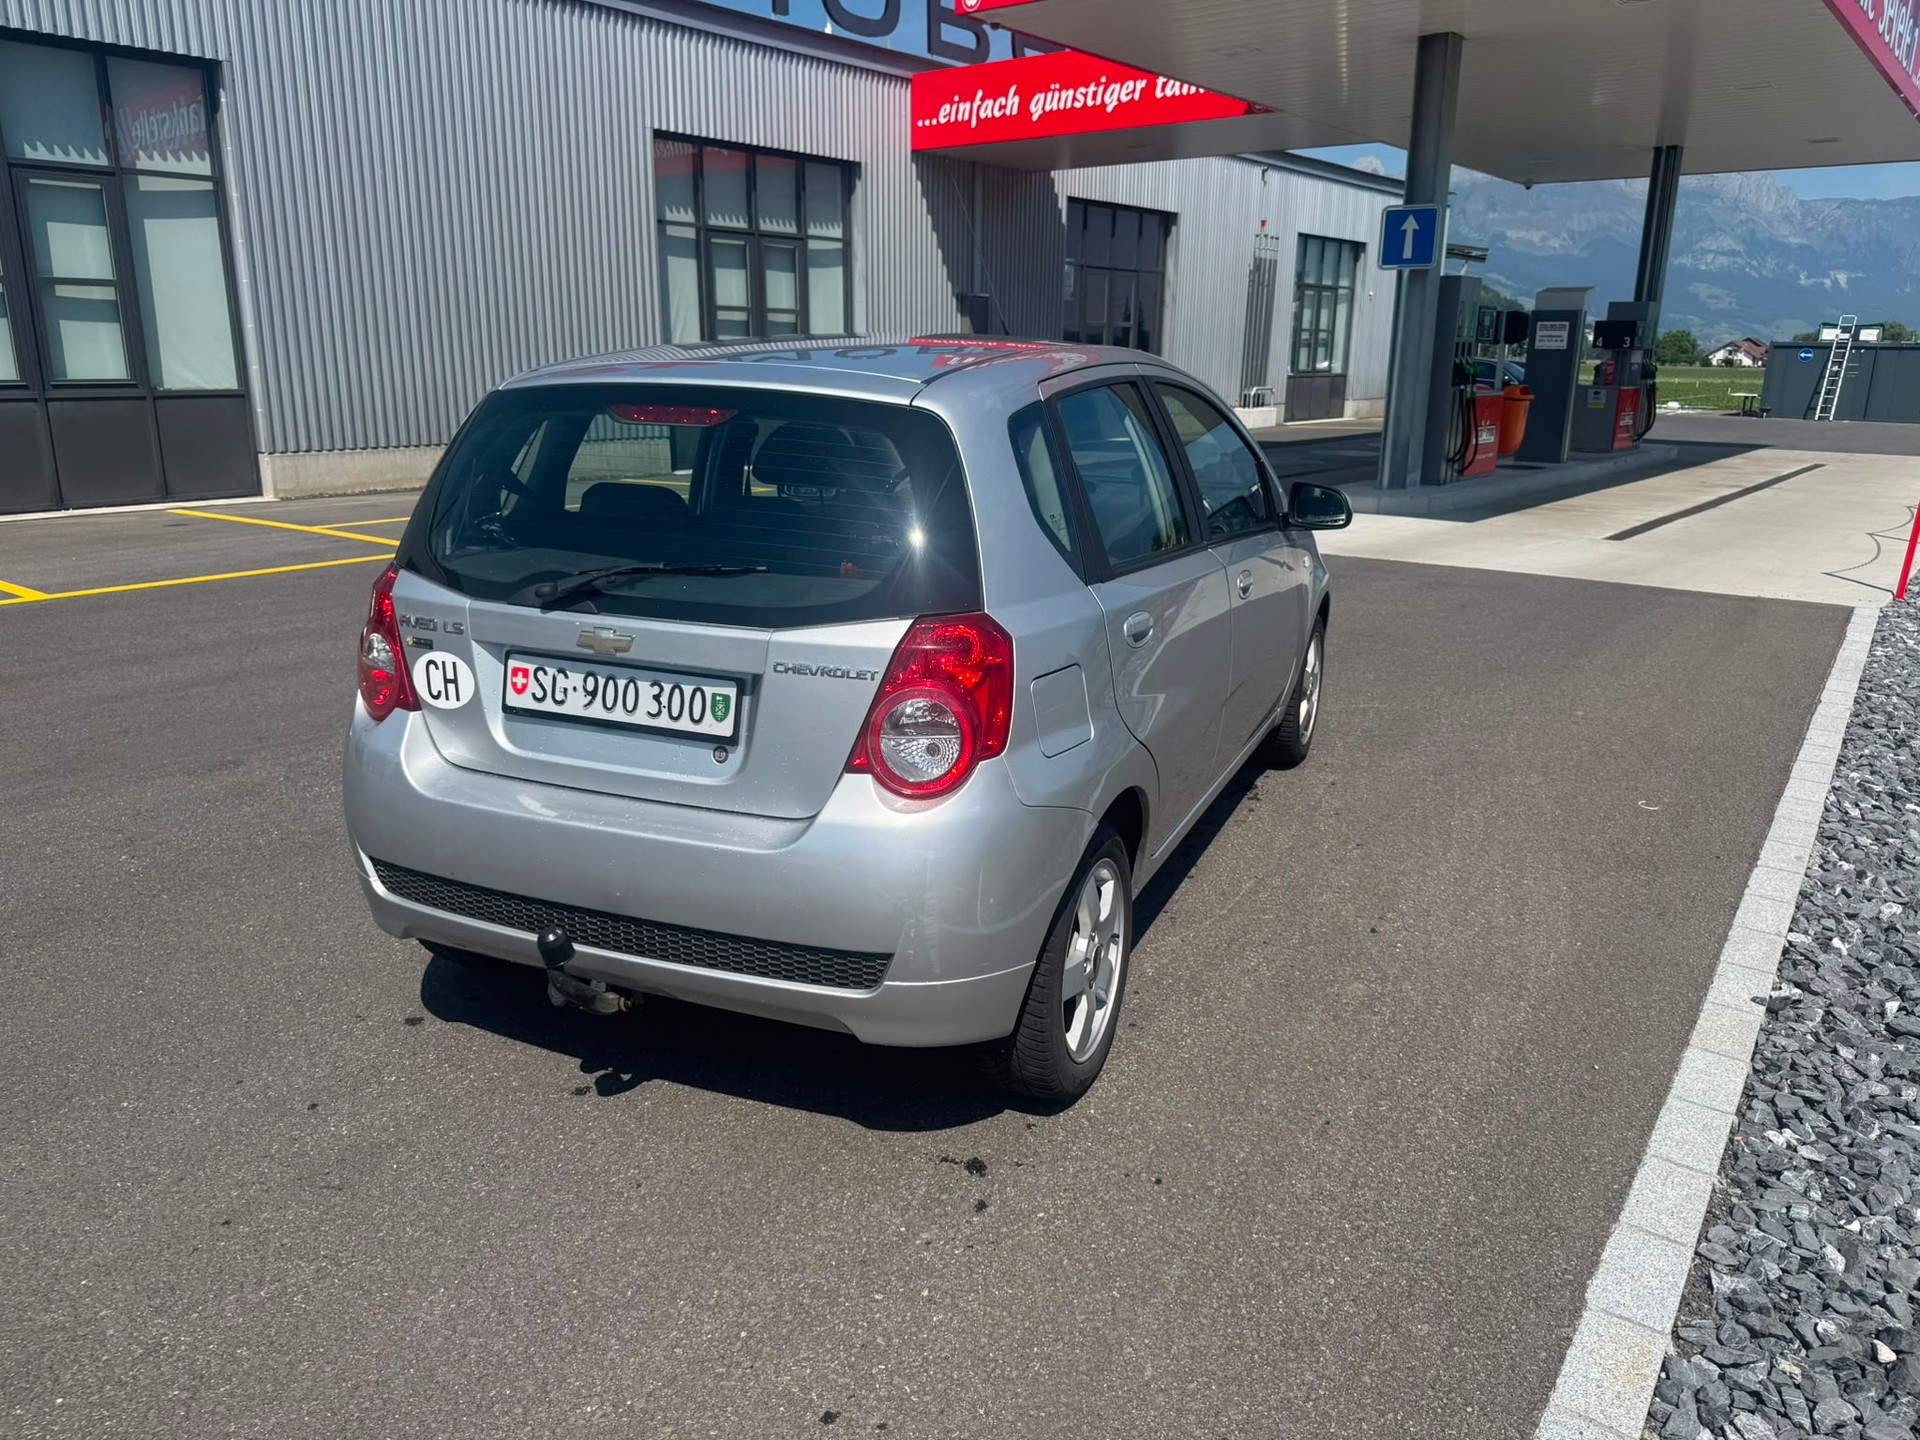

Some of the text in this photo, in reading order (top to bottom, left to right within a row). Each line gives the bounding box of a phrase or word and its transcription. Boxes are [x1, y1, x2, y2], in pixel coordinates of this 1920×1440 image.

[1029, 76, 1148, 122] günstiger
[1596, 336, 1603, 348] 4
[1622, 336, 1631, 348] 3
[425, 659, 461, 702] CH
[773, 660, 879, 682] CHEVROLET
